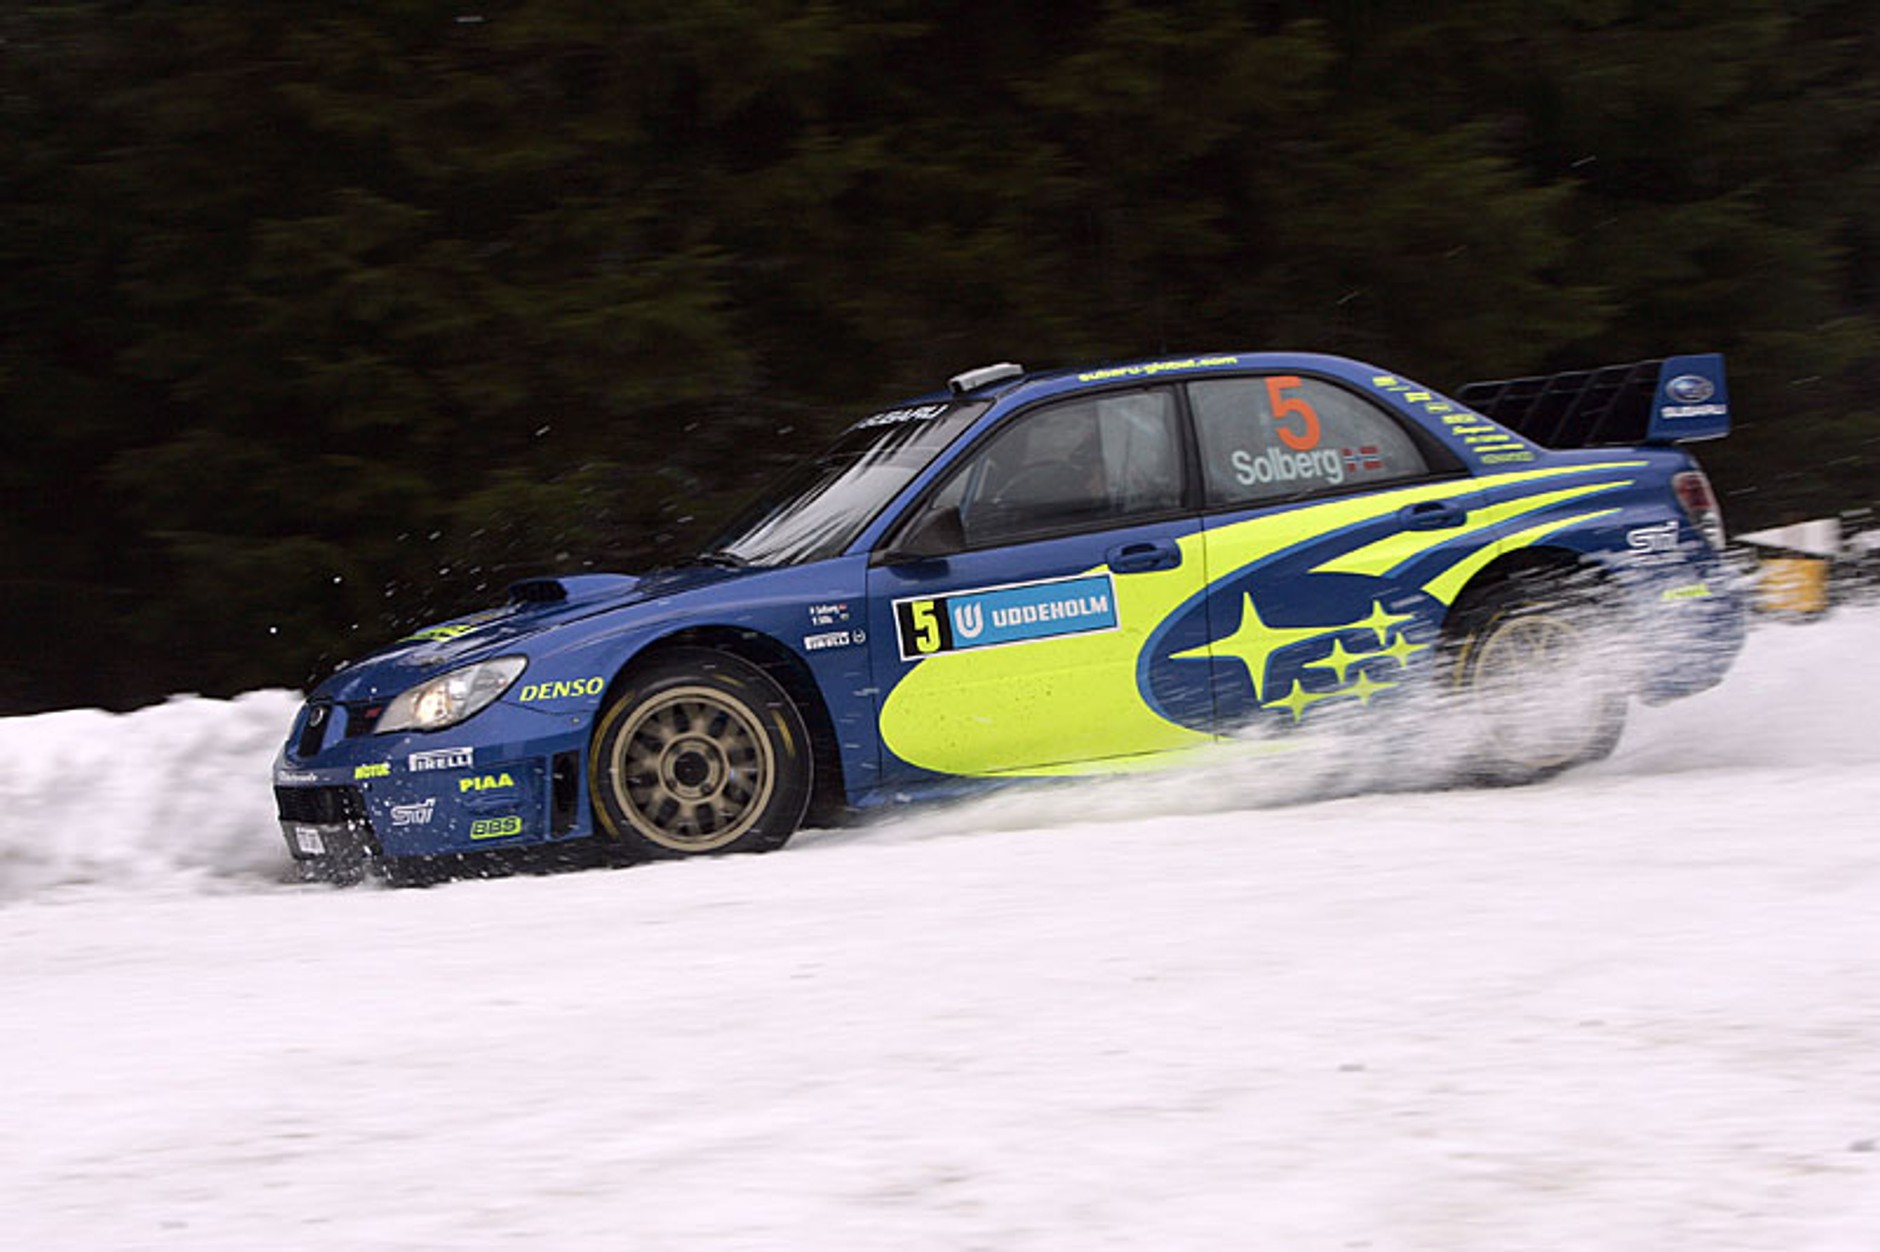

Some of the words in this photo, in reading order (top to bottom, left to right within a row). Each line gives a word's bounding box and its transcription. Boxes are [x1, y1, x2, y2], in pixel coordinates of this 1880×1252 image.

[1265, 376, 1321, 450] 5
[1232, 446, 1342, 484] Solberg
[992, 596, 1108, 627] UDDEHOLM
[911, 601, 941, 653] 5
[519, 677, 604, 701] DENSO
[408, 747, 473, 771] PIRELLI
[459, 774, 514, 792] PIAA
[473, 817, 518, 837] BBS
